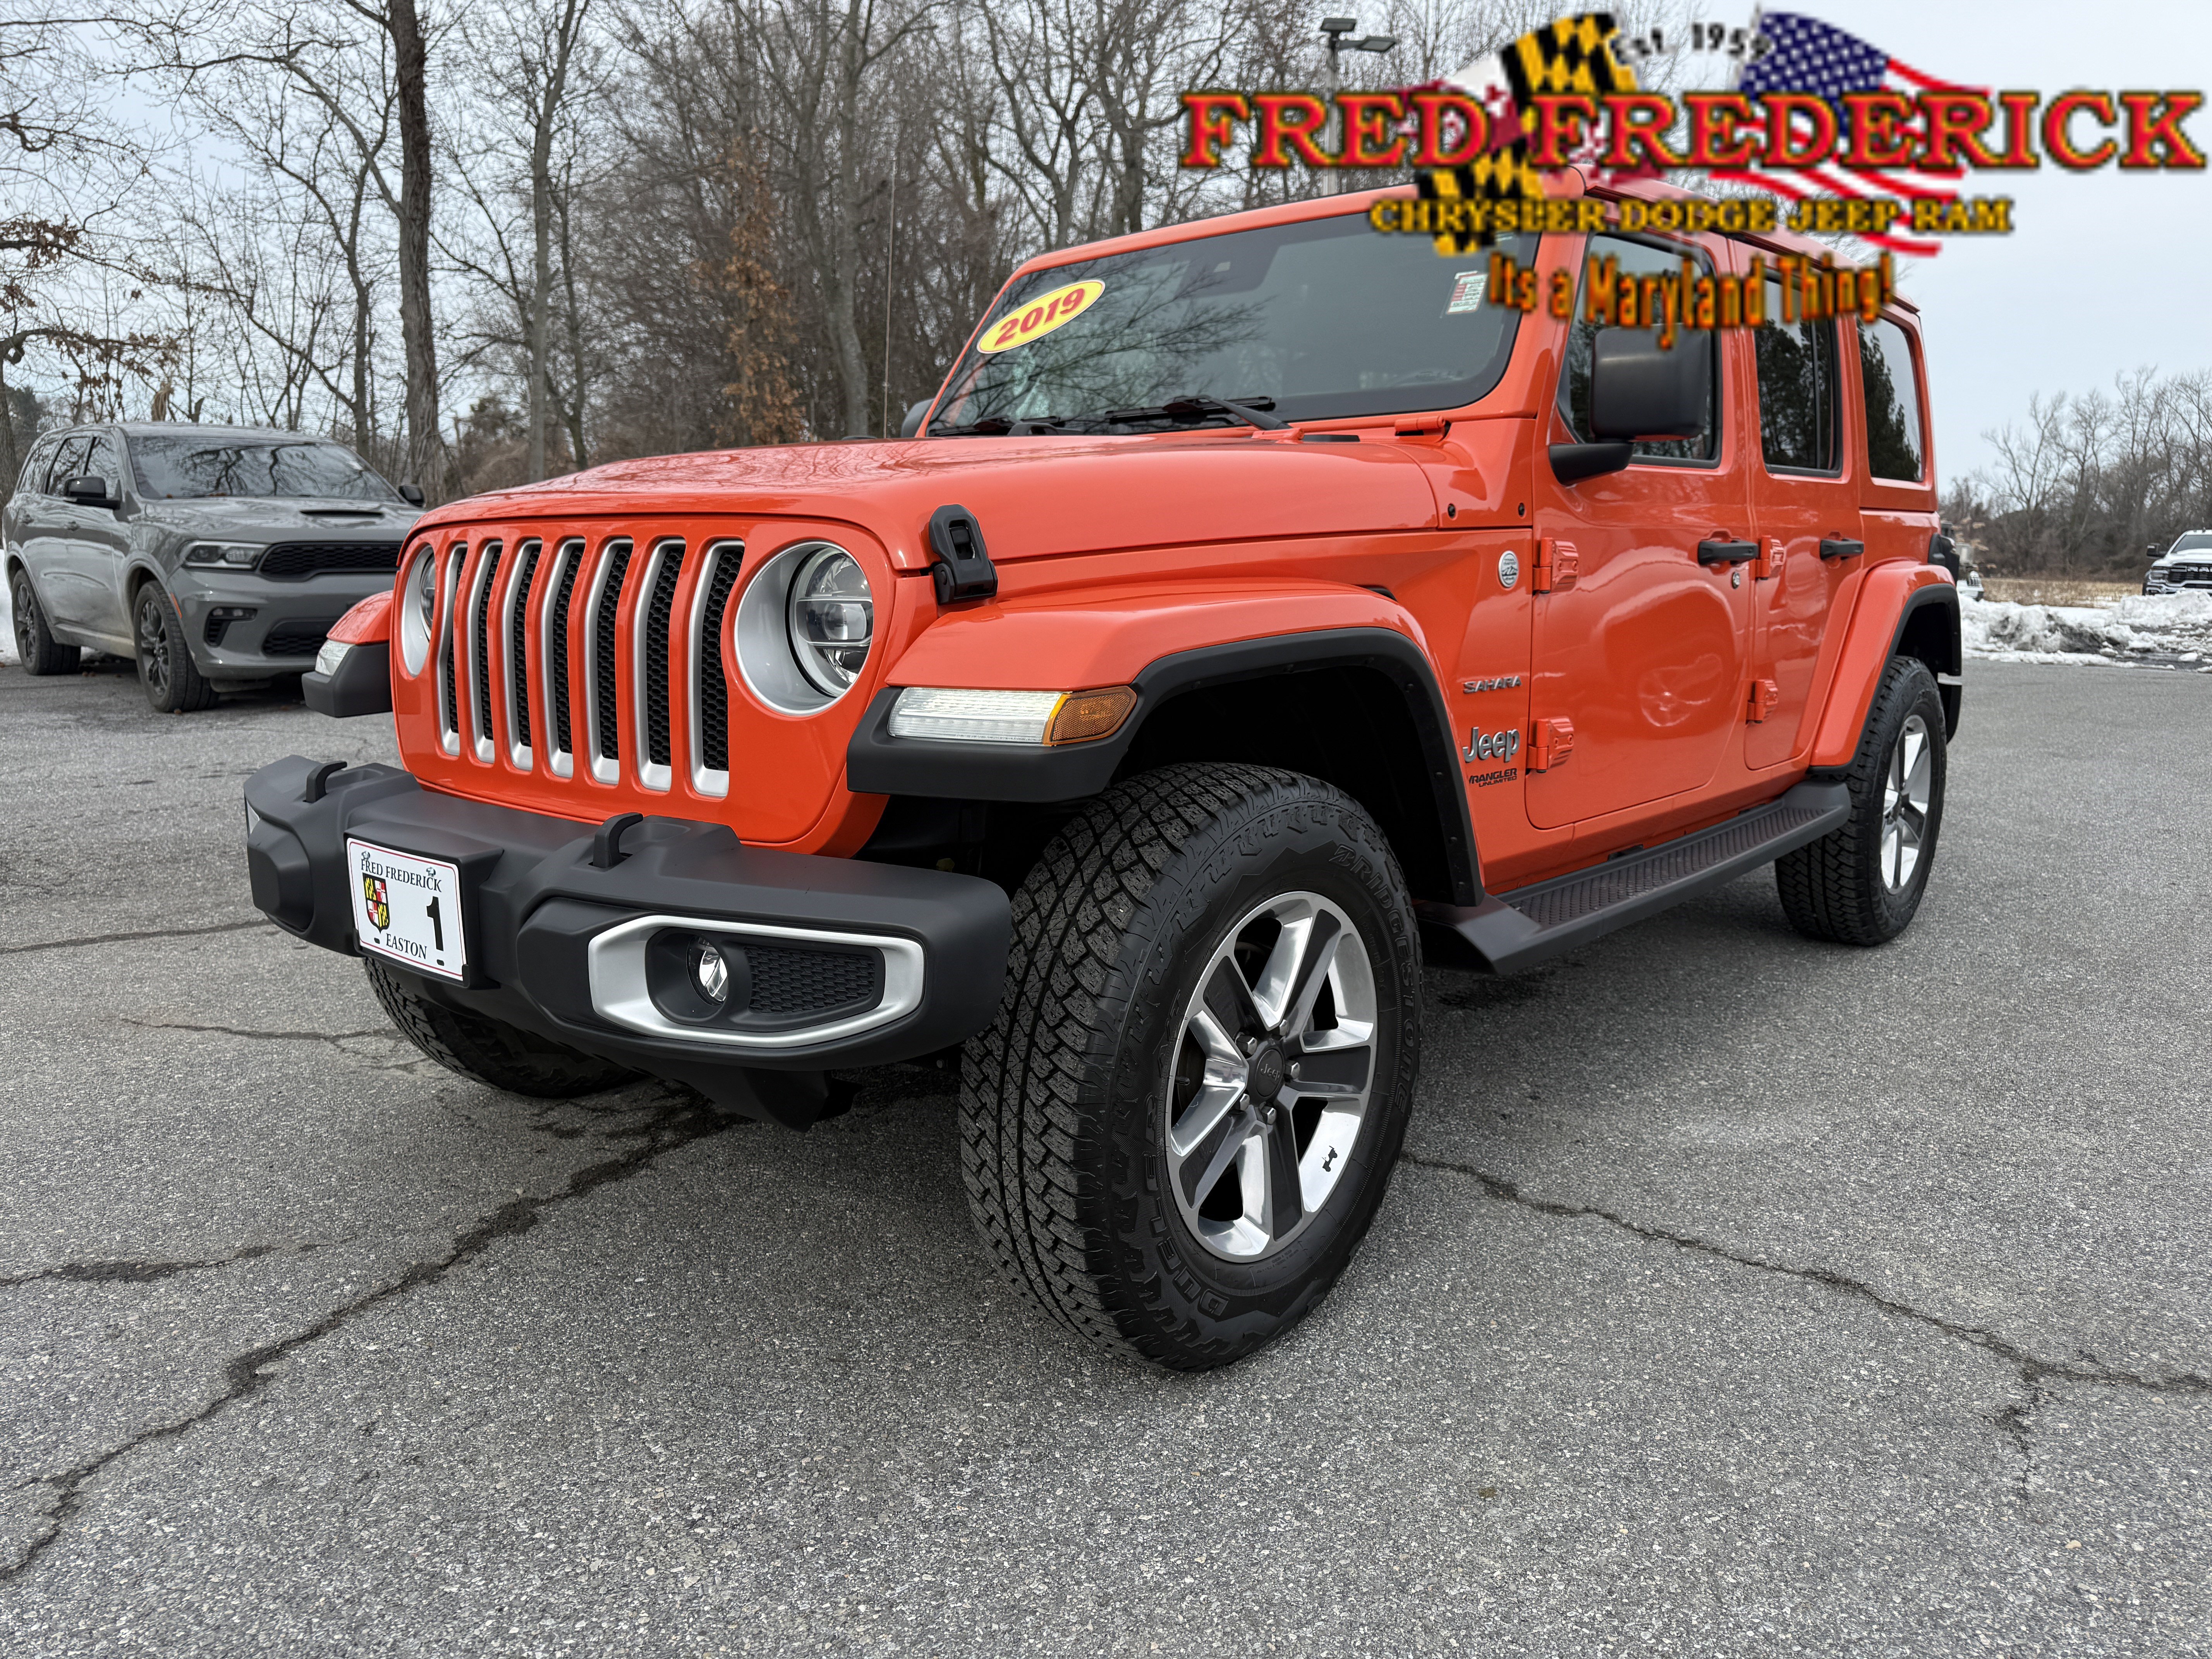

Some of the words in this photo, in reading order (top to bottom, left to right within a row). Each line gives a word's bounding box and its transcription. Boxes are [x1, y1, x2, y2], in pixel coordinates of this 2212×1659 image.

[994, 288, 1085, 349] 2019
[1463, 675, 1522, 694] SAHARA
[1462, 726, 1520, 763] Jeep
[361, 859, 383, 876] FRED
[385, 866, 442, 893] FREDERICK
[426, 896, 444, 951] 1
[386, 933, 428, 960] EASTON
[1329, 844, 1417, 1114] BRIDGESTONE
[1261, 1063, 1280, 1082] Jeep
